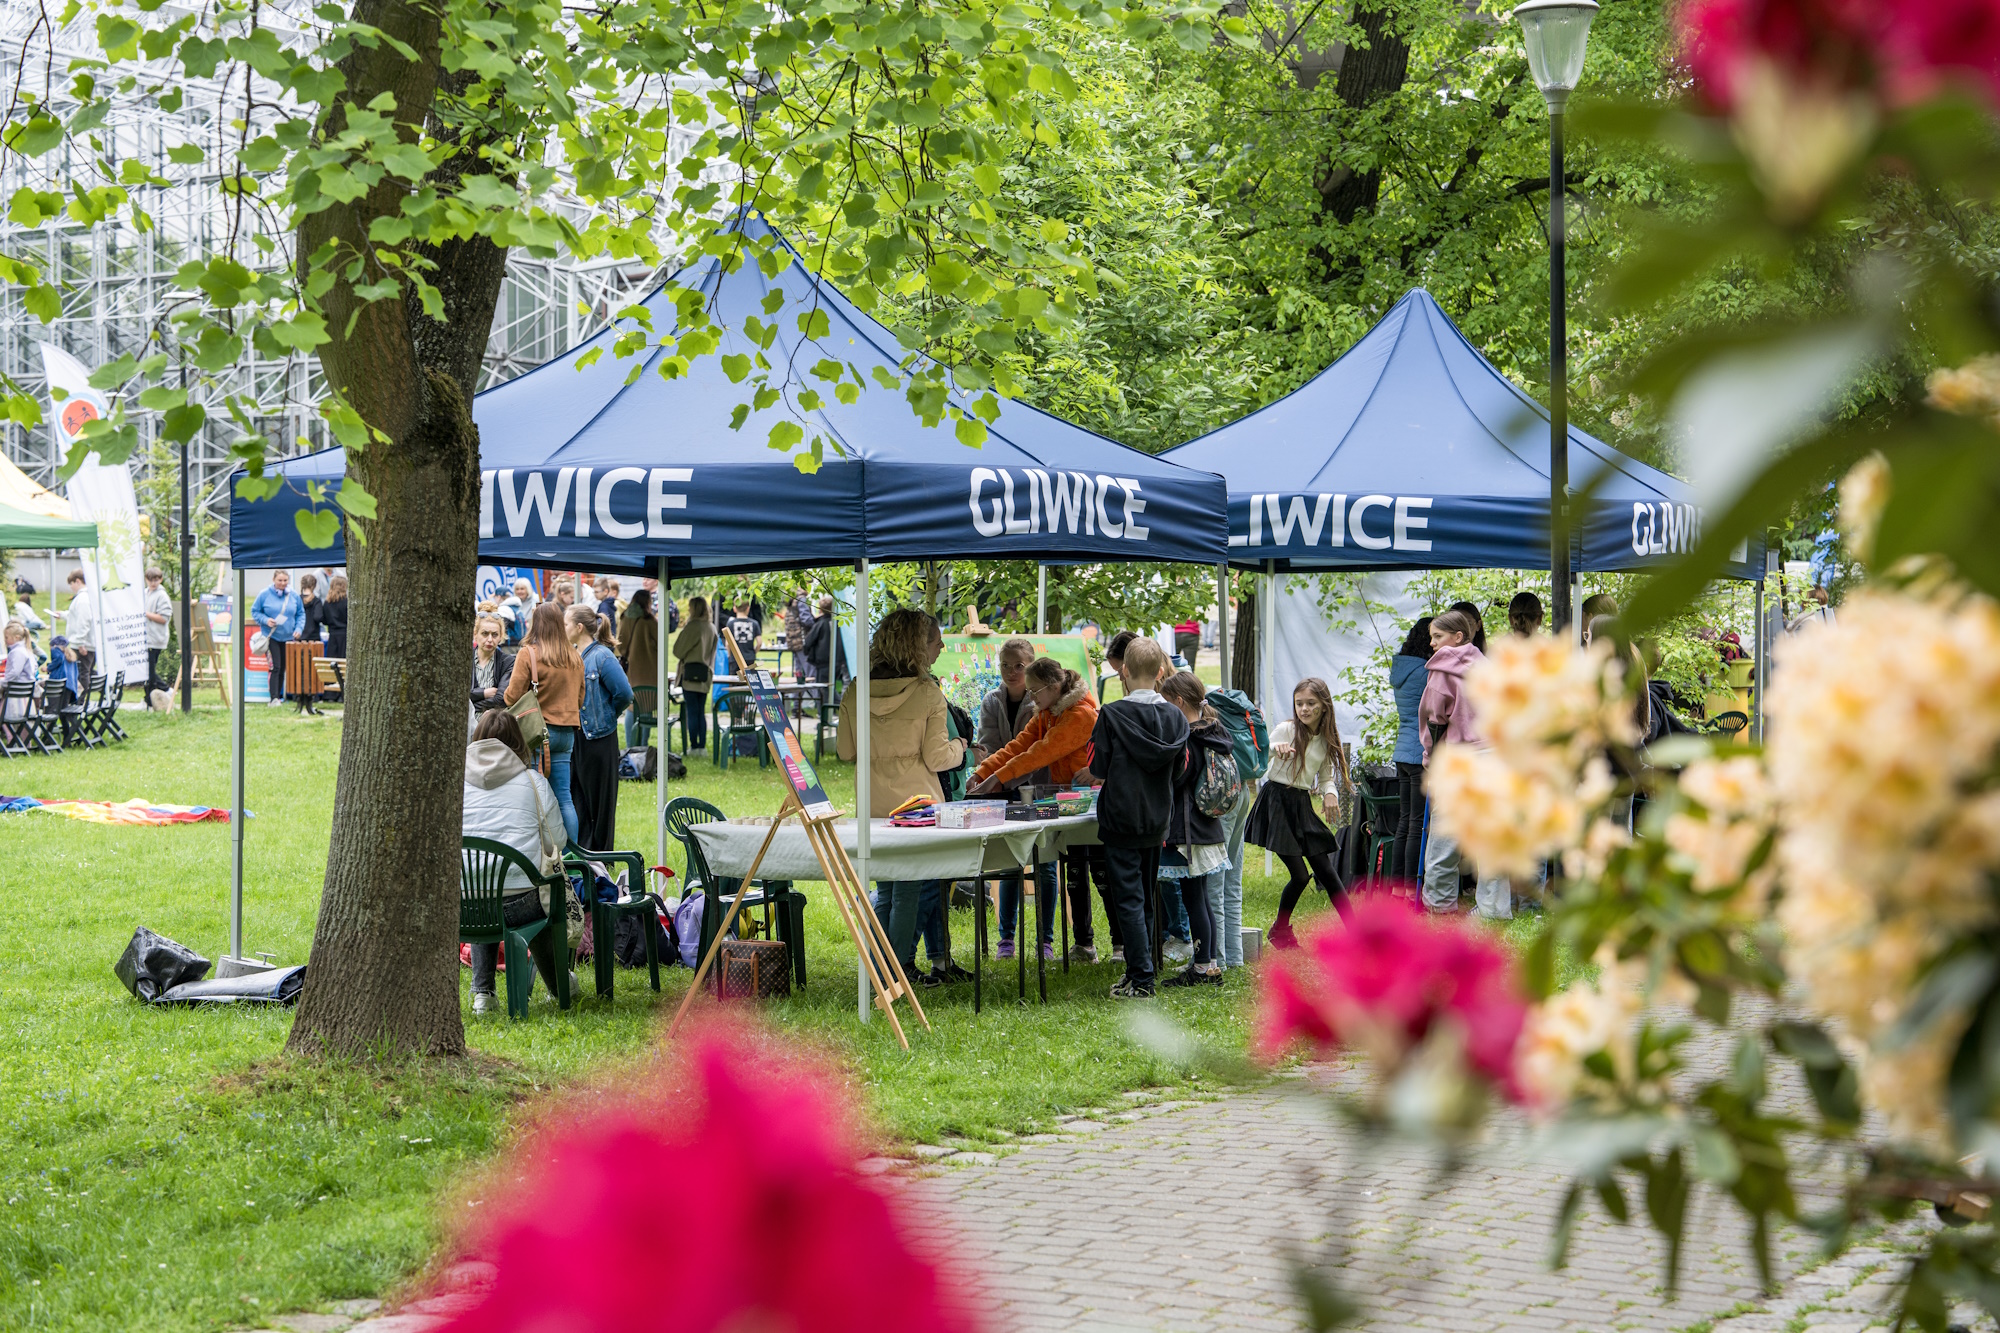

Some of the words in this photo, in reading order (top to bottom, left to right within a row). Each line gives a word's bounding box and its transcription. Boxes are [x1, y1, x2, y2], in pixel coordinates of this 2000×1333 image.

[479, 467, 694, 539] IWICE
[969, 467, 1150, 541] GLIWICE
[1228, 493, 1434, 552] IWICE
[1632, 501, 1706, 556] GLIWI
[954, 642, 979, 653] nasz
